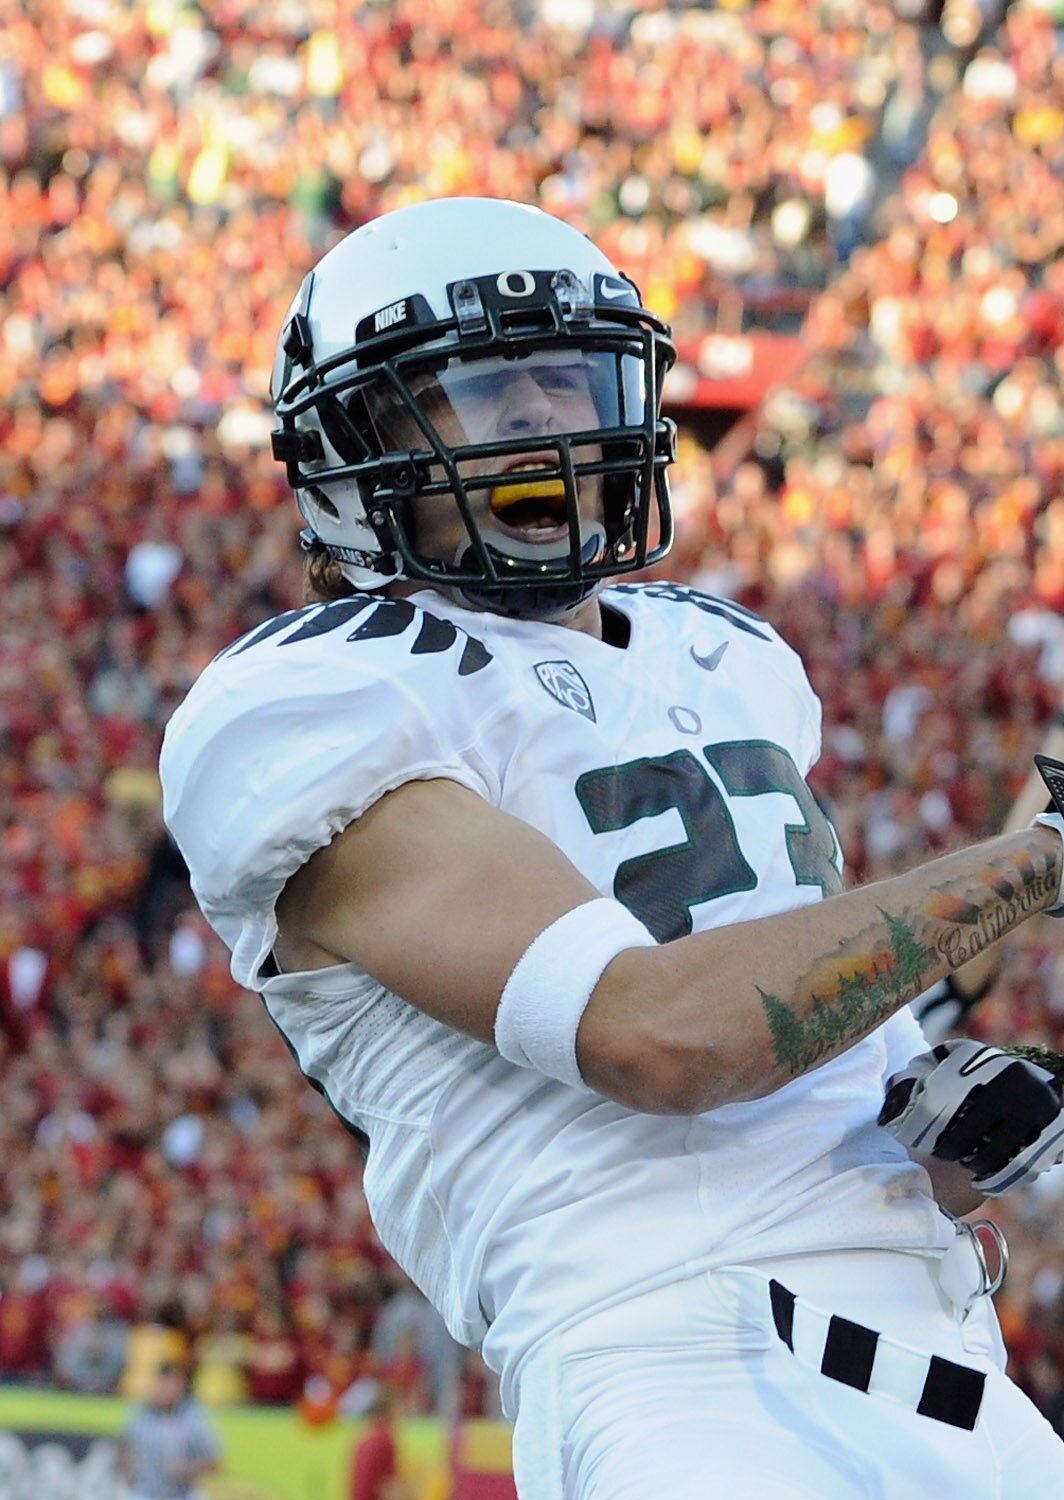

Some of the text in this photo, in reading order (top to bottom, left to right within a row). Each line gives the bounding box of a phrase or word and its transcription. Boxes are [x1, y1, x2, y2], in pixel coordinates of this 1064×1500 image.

[496, 270, 536, 298] O
[374, 300, 408, 333] NIKE
[667, 705, 703, 735] O
[575, 739, 845, 945] 23
